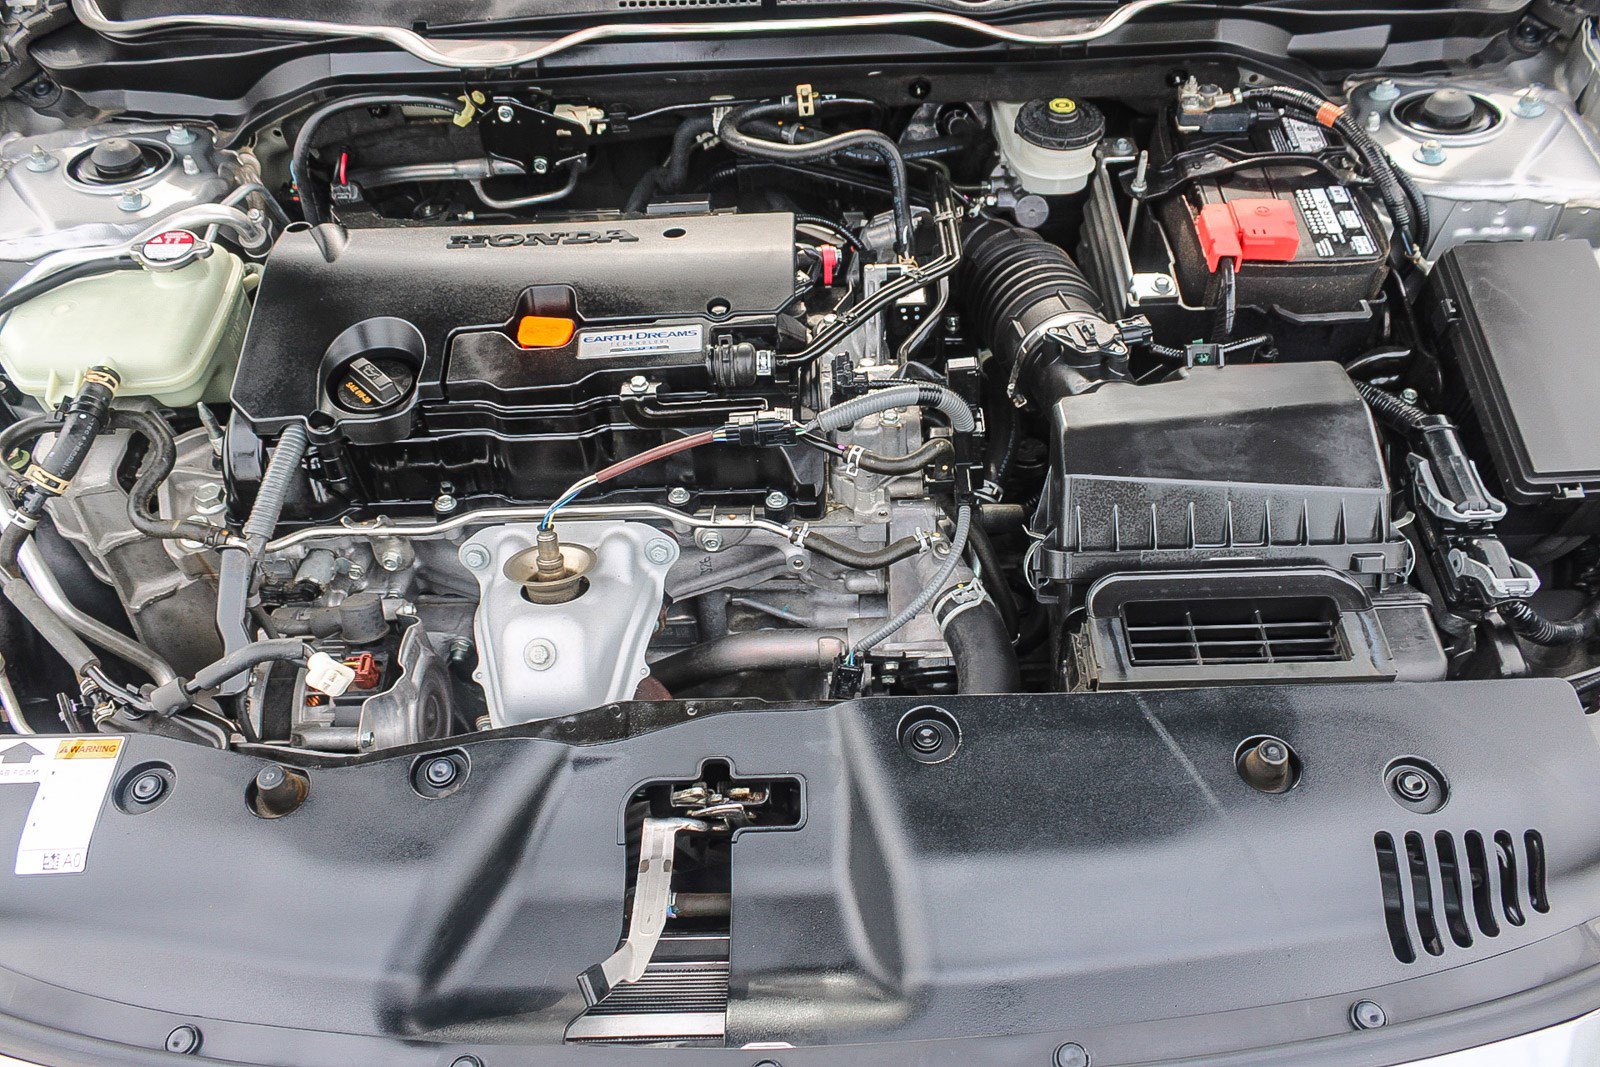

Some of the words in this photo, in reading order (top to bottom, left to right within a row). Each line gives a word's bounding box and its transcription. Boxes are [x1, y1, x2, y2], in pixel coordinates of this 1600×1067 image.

[446, 229, 639, 249] HONDA
[583, 330, 633, 343] EARTH
[636, 329, 698, 340] DREAMS
[70, 744, 117, 754] WARNING
